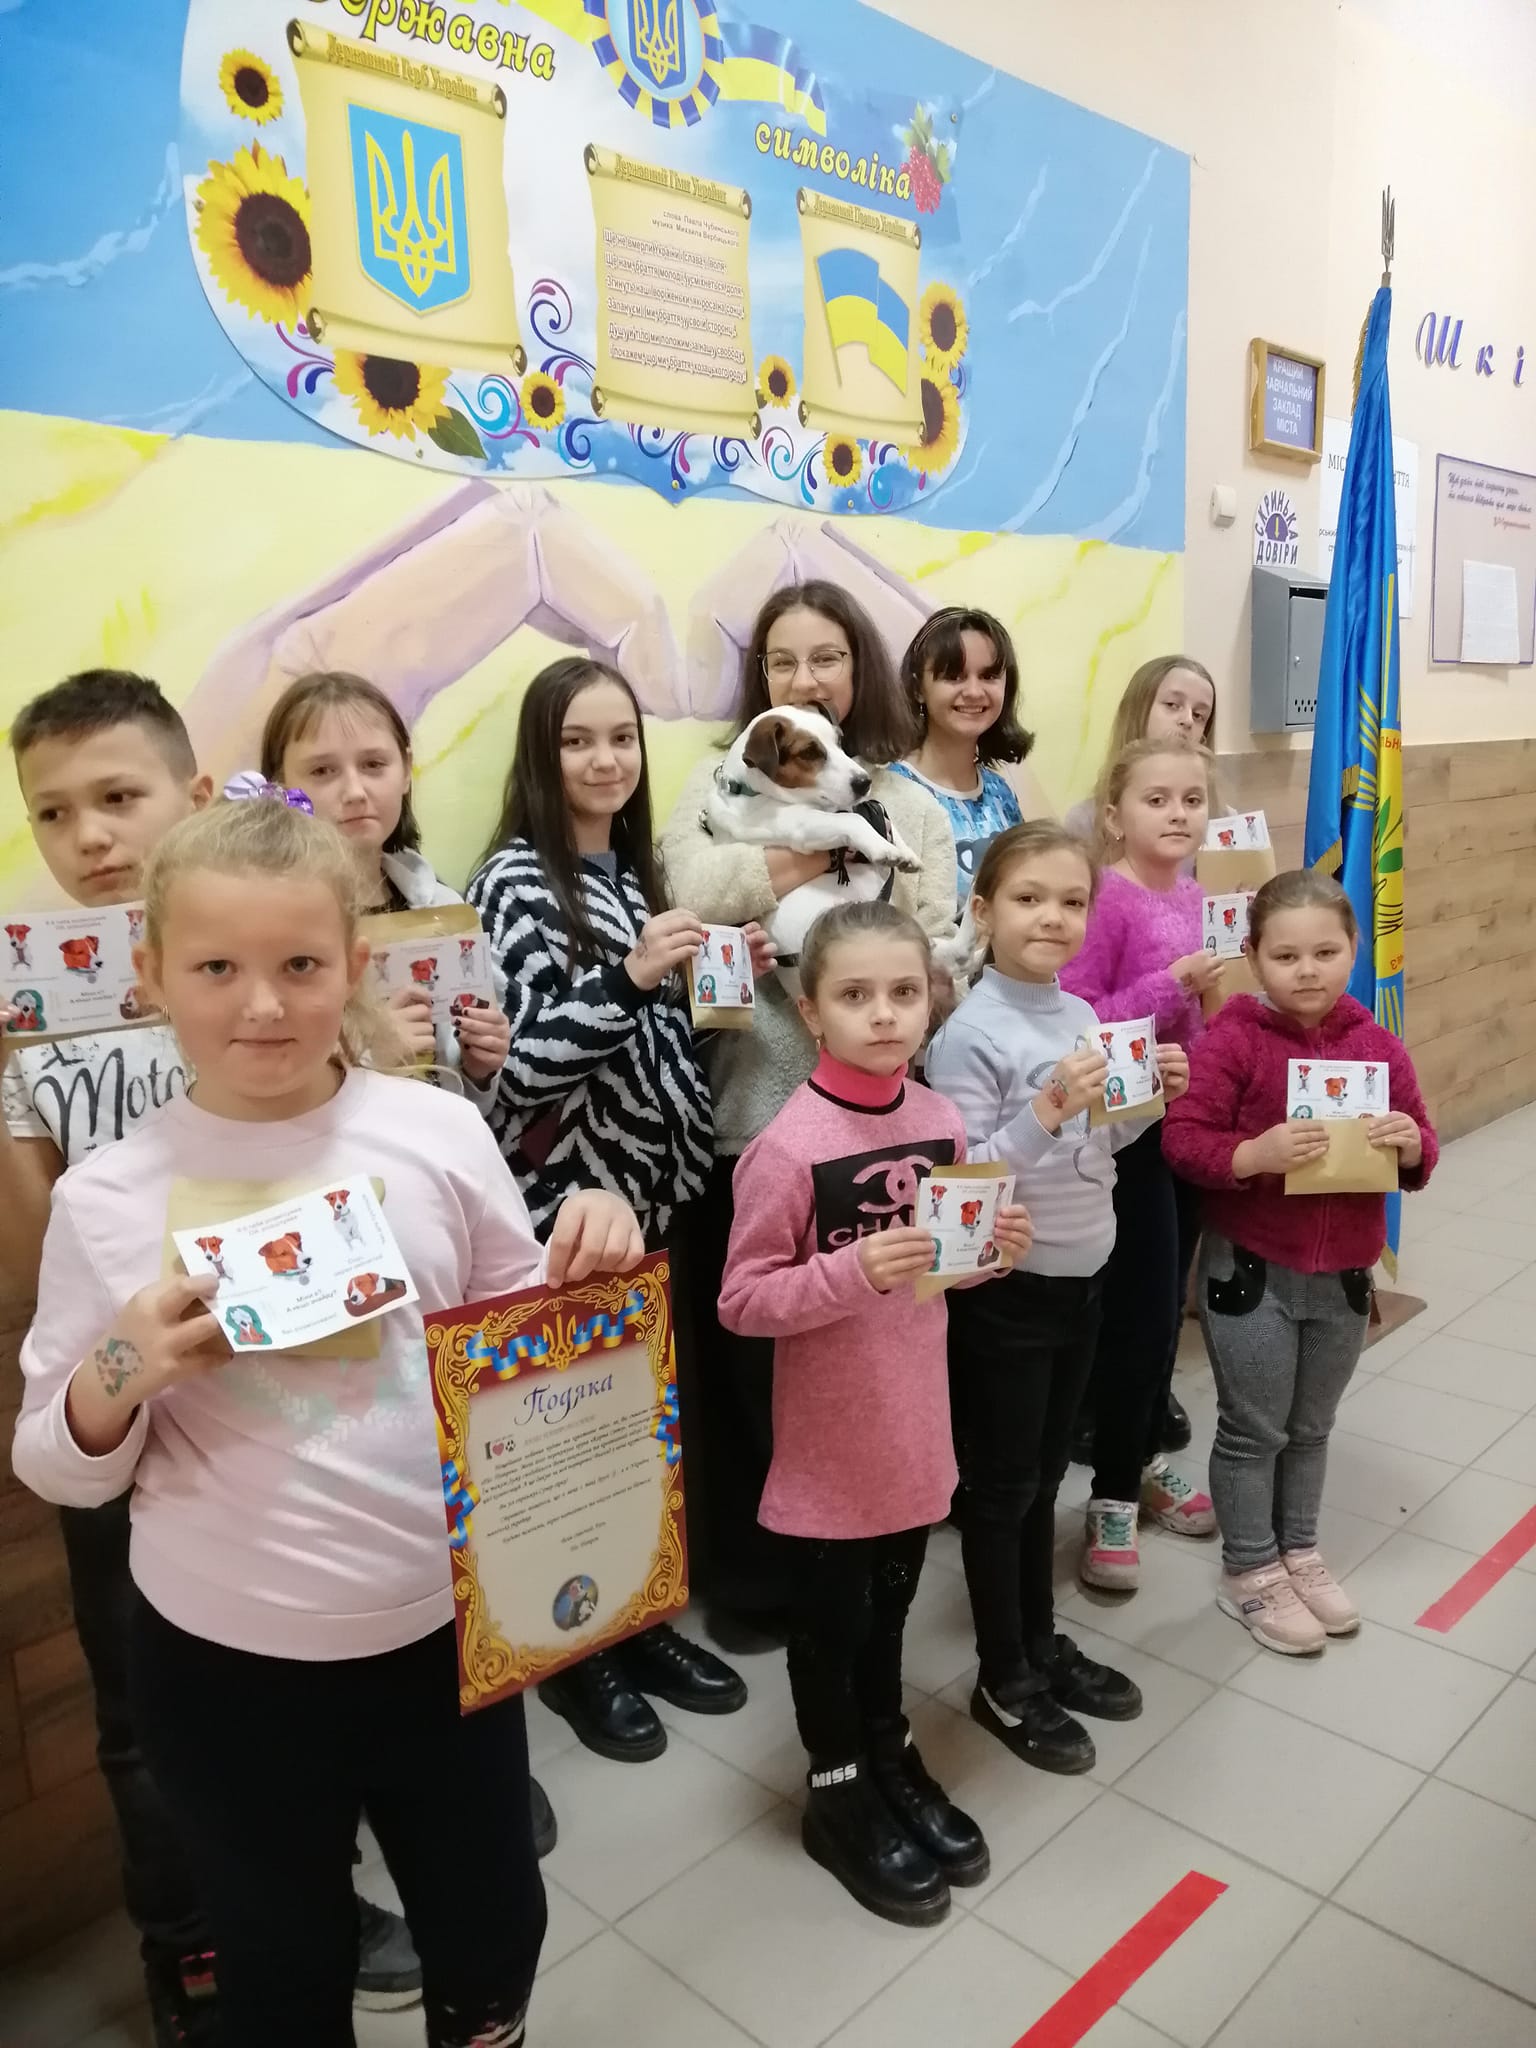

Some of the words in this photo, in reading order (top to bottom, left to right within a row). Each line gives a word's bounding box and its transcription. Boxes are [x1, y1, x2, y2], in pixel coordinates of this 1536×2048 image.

[755, 121, 912, 200] символіка
[1272, 397, 1302, 421] ЗАКЛАД
[1276, 417, 1298, 436] МІСТА
[1328, 453, 1347, 471] МІС
[1255, 489, 1299, 540] СКРИНЬКА
[1255, 540, 1298, 566] ДОВІРИ
[514, 1374, 614, 1426] Подяка
[811, 1763, 857, 1788] MISS
